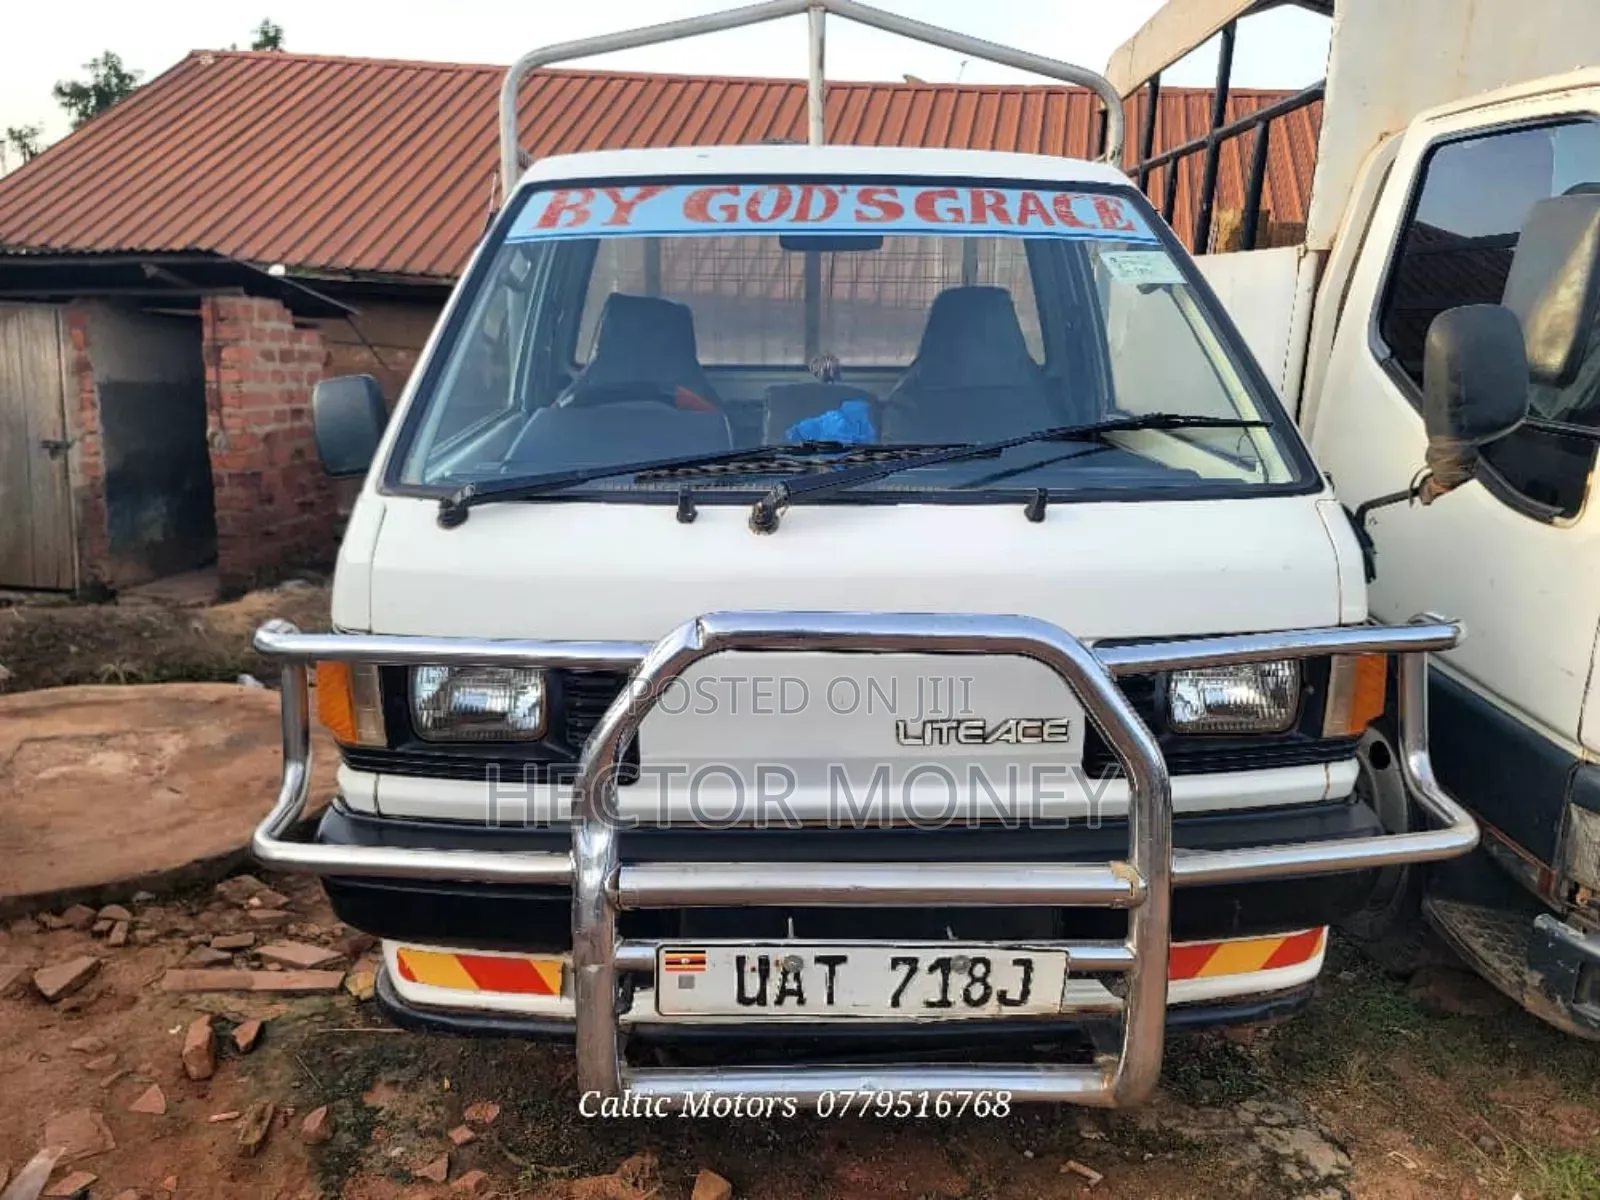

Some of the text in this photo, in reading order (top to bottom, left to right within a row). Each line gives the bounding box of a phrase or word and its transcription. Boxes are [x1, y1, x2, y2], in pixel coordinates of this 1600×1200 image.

[535, 187, 666, 229] BY
[914, 187, 1137, 231] GRACE
[735, 955, 1034, 1008] UAT 718J
